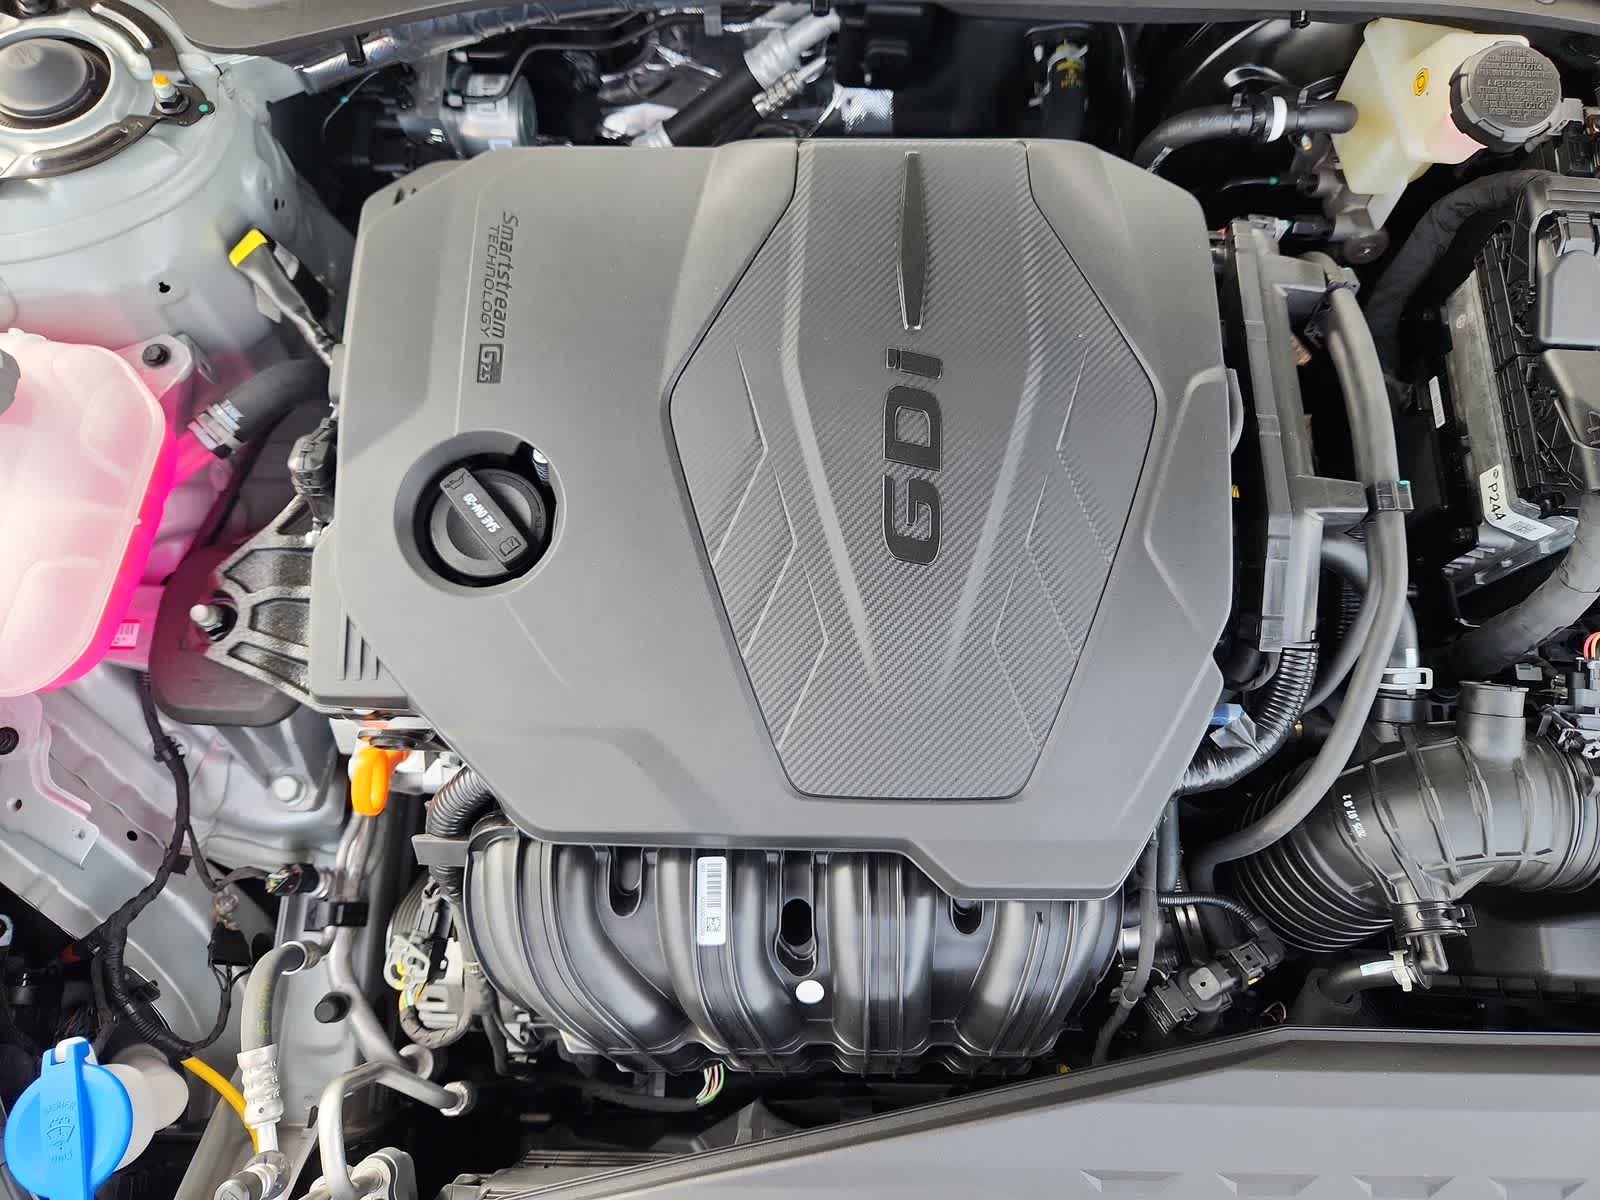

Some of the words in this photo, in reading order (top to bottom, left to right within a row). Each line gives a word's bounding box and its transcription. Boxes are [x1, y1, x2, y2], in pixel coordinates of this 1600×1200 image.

[480, 225, 500, 338] TECHNOLOGY
[492, 211, 519, 339] Smartstream
[463, 492, 488, 519] 0W-20
[480, 513, 501, 533] SAE
